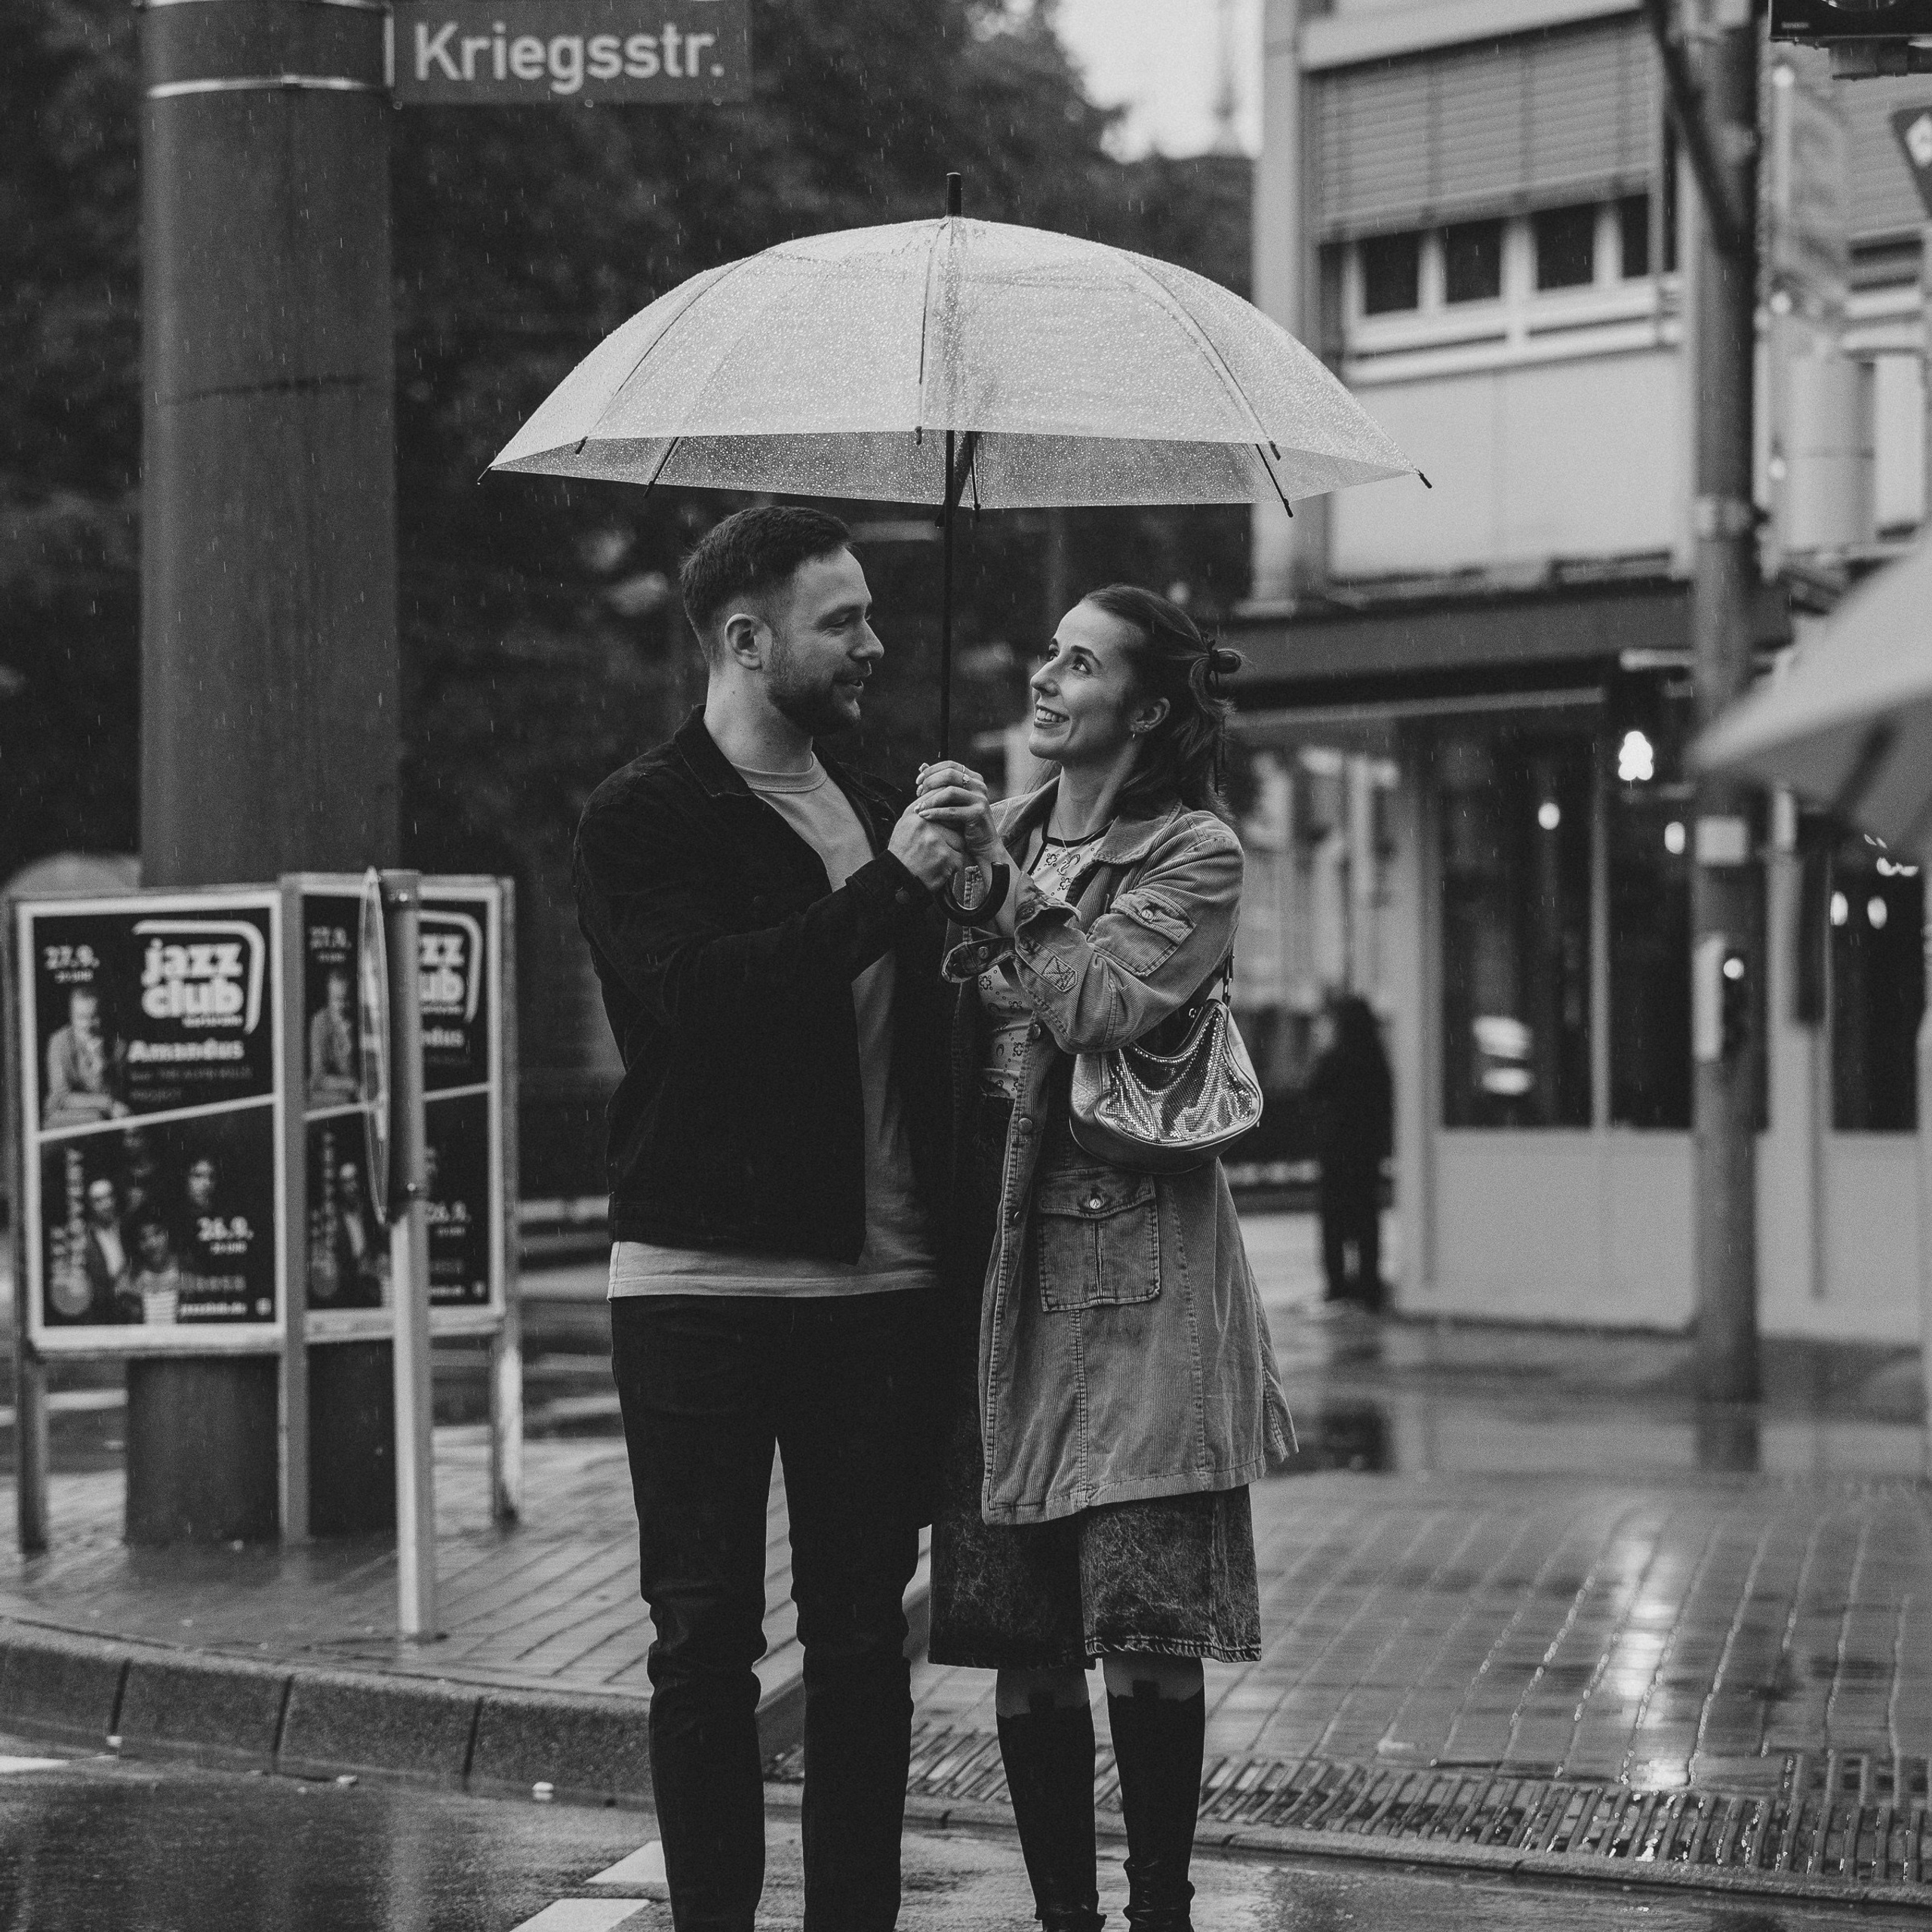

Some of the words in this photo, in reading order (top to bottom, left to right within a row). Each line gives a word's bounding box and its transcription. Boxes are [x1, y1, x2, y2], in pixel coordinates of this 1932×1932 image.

[414, 20, 724, 95] Kriegsstr.
[140, 937, 243, 986] jazz
[141, 978, 245, 1019] club
